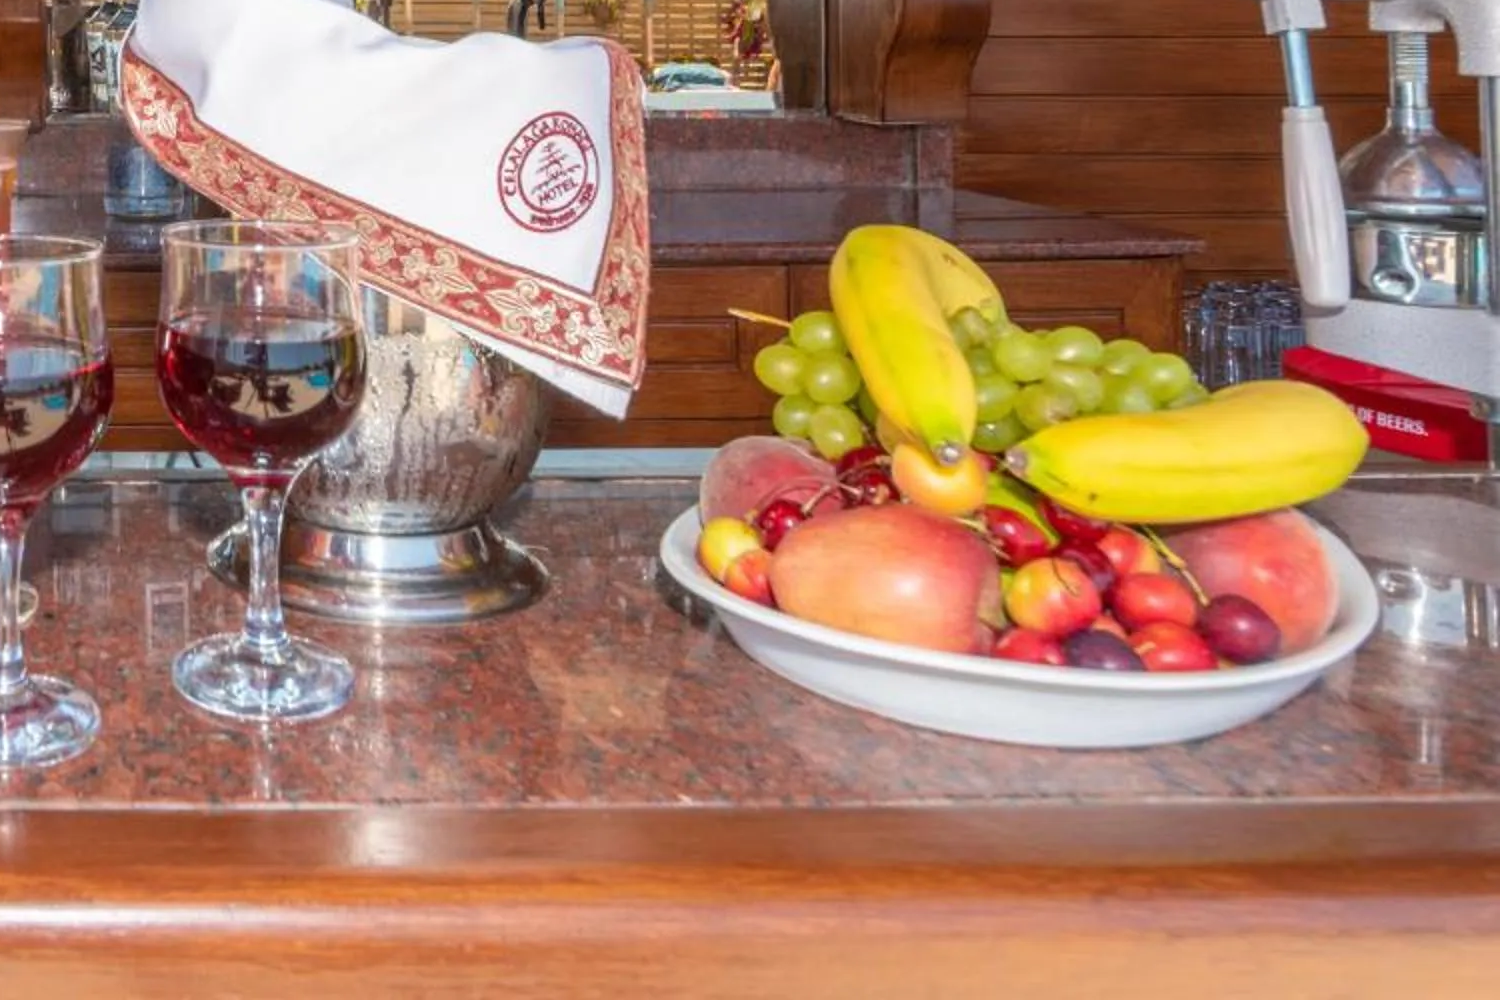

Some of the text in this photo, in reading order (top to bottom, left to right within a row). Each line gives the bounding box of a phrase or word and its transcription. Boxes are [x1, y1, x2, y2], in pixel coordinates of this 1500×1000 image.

[538, 177, 579, 206] HOTEL
[1357, 407, 1375, 424] OF
[1376, 411, 1429, 437] BEERS.
